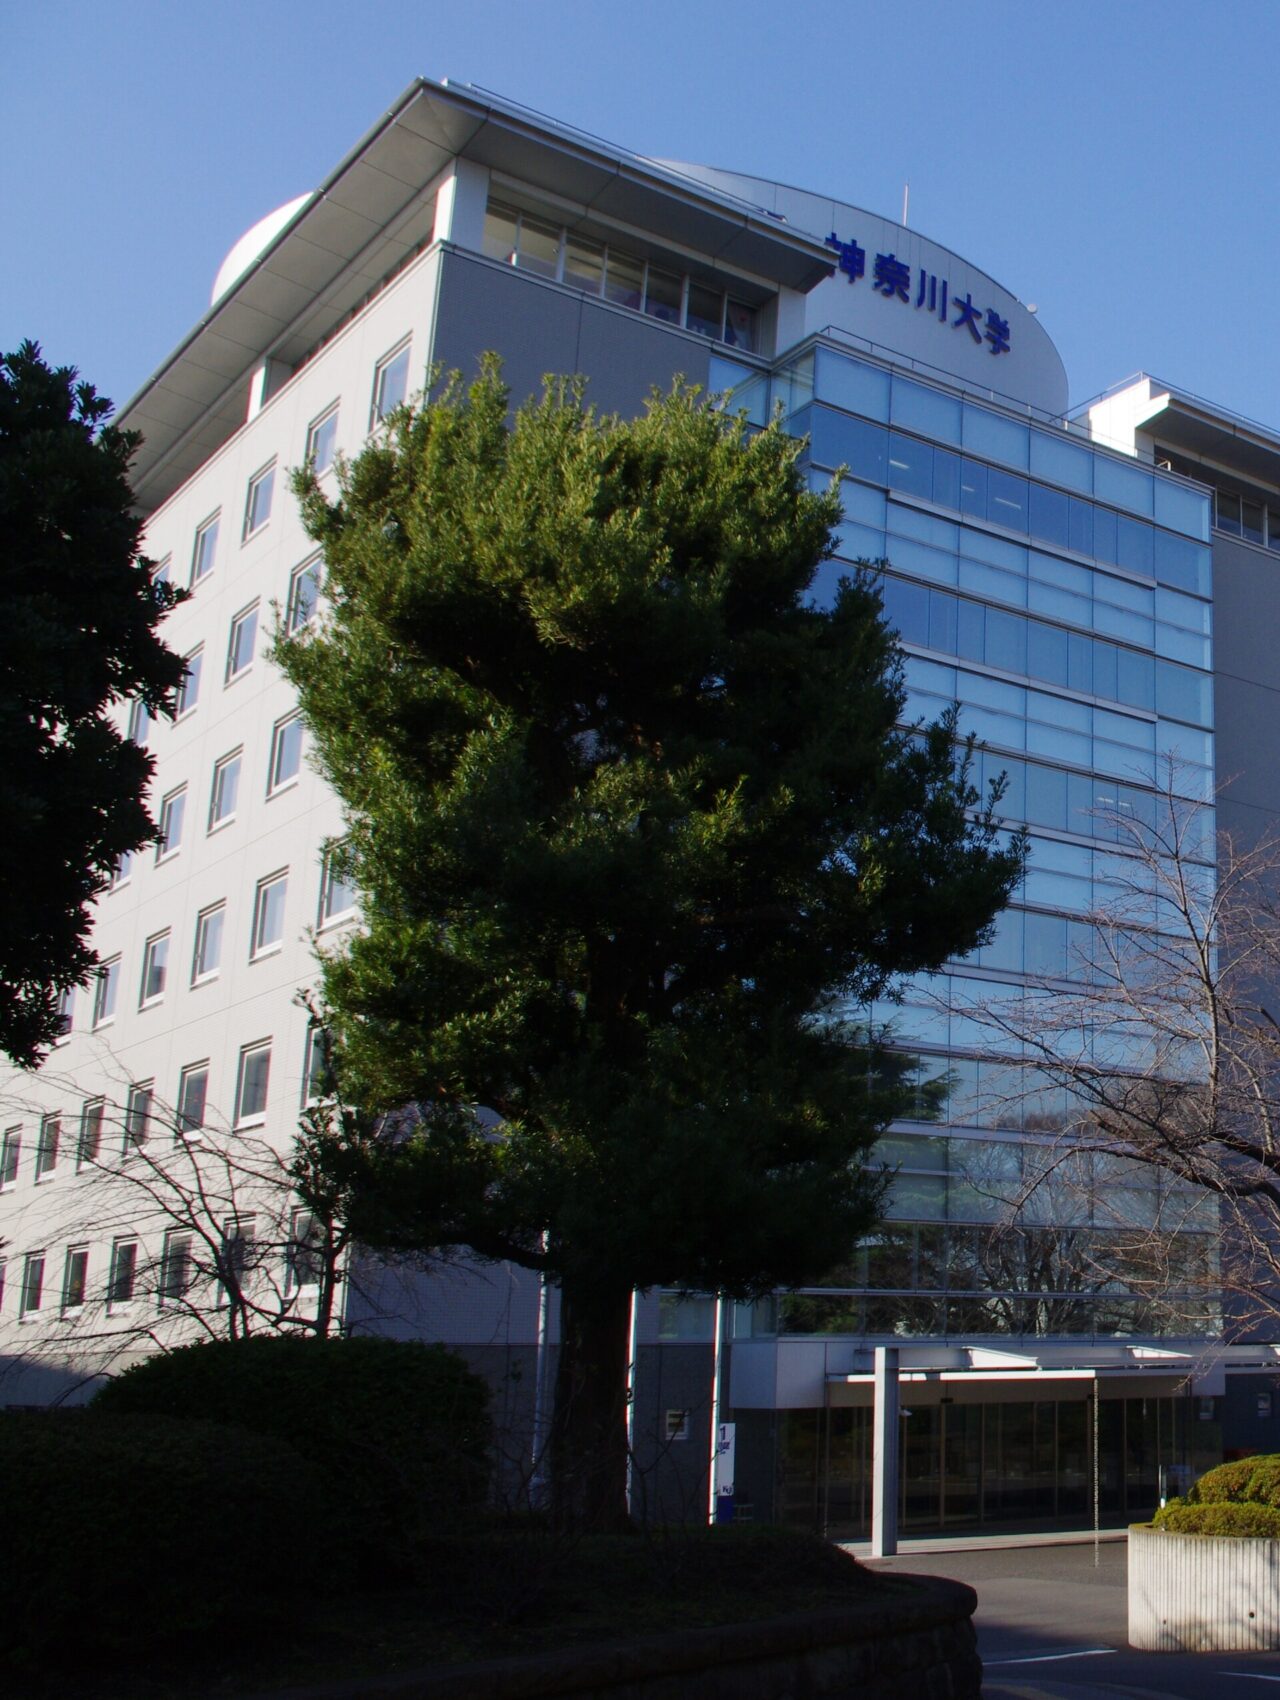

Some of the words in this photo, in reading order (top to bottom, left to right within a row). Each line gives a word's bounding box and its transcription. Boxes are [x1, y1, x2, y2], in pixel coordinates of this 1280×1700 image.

[825, 232, 1010, 355] 神奈川大学
